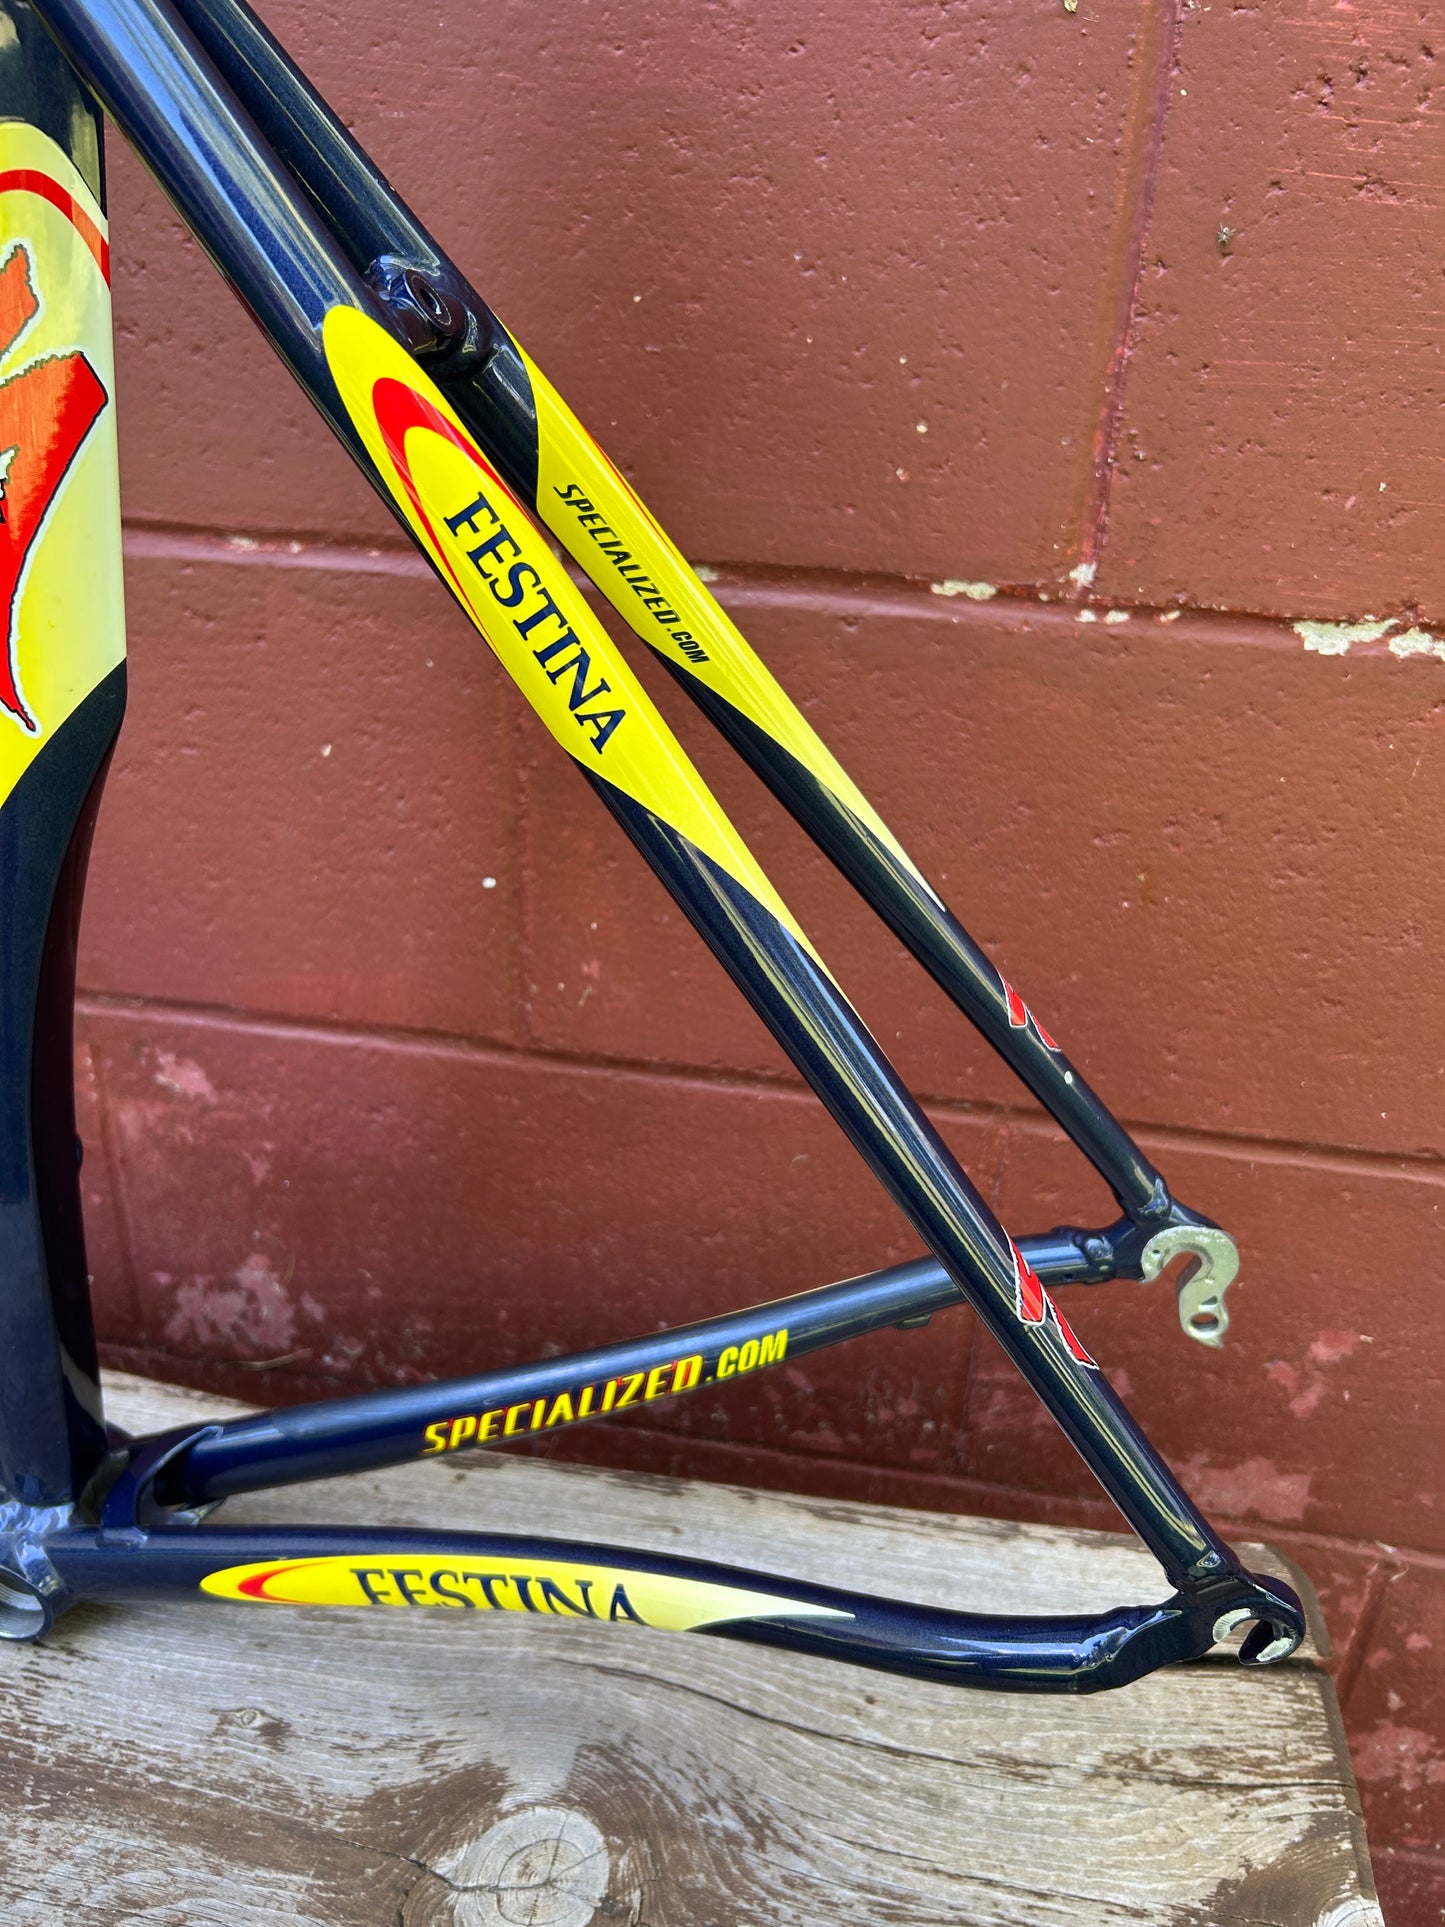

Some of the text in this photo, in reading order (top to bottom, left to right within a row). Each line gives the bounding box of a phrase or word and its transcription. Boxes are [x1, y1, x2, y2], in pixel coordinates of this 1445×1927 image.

[443, 491, 626, 755] FESTINA
[553, 483, 710, 664] SPECIALIZED.COM
[422, 1328, 788, 1455] SPECIALIZED.COM
[350, 1568, 651, 1626] FESTINA
